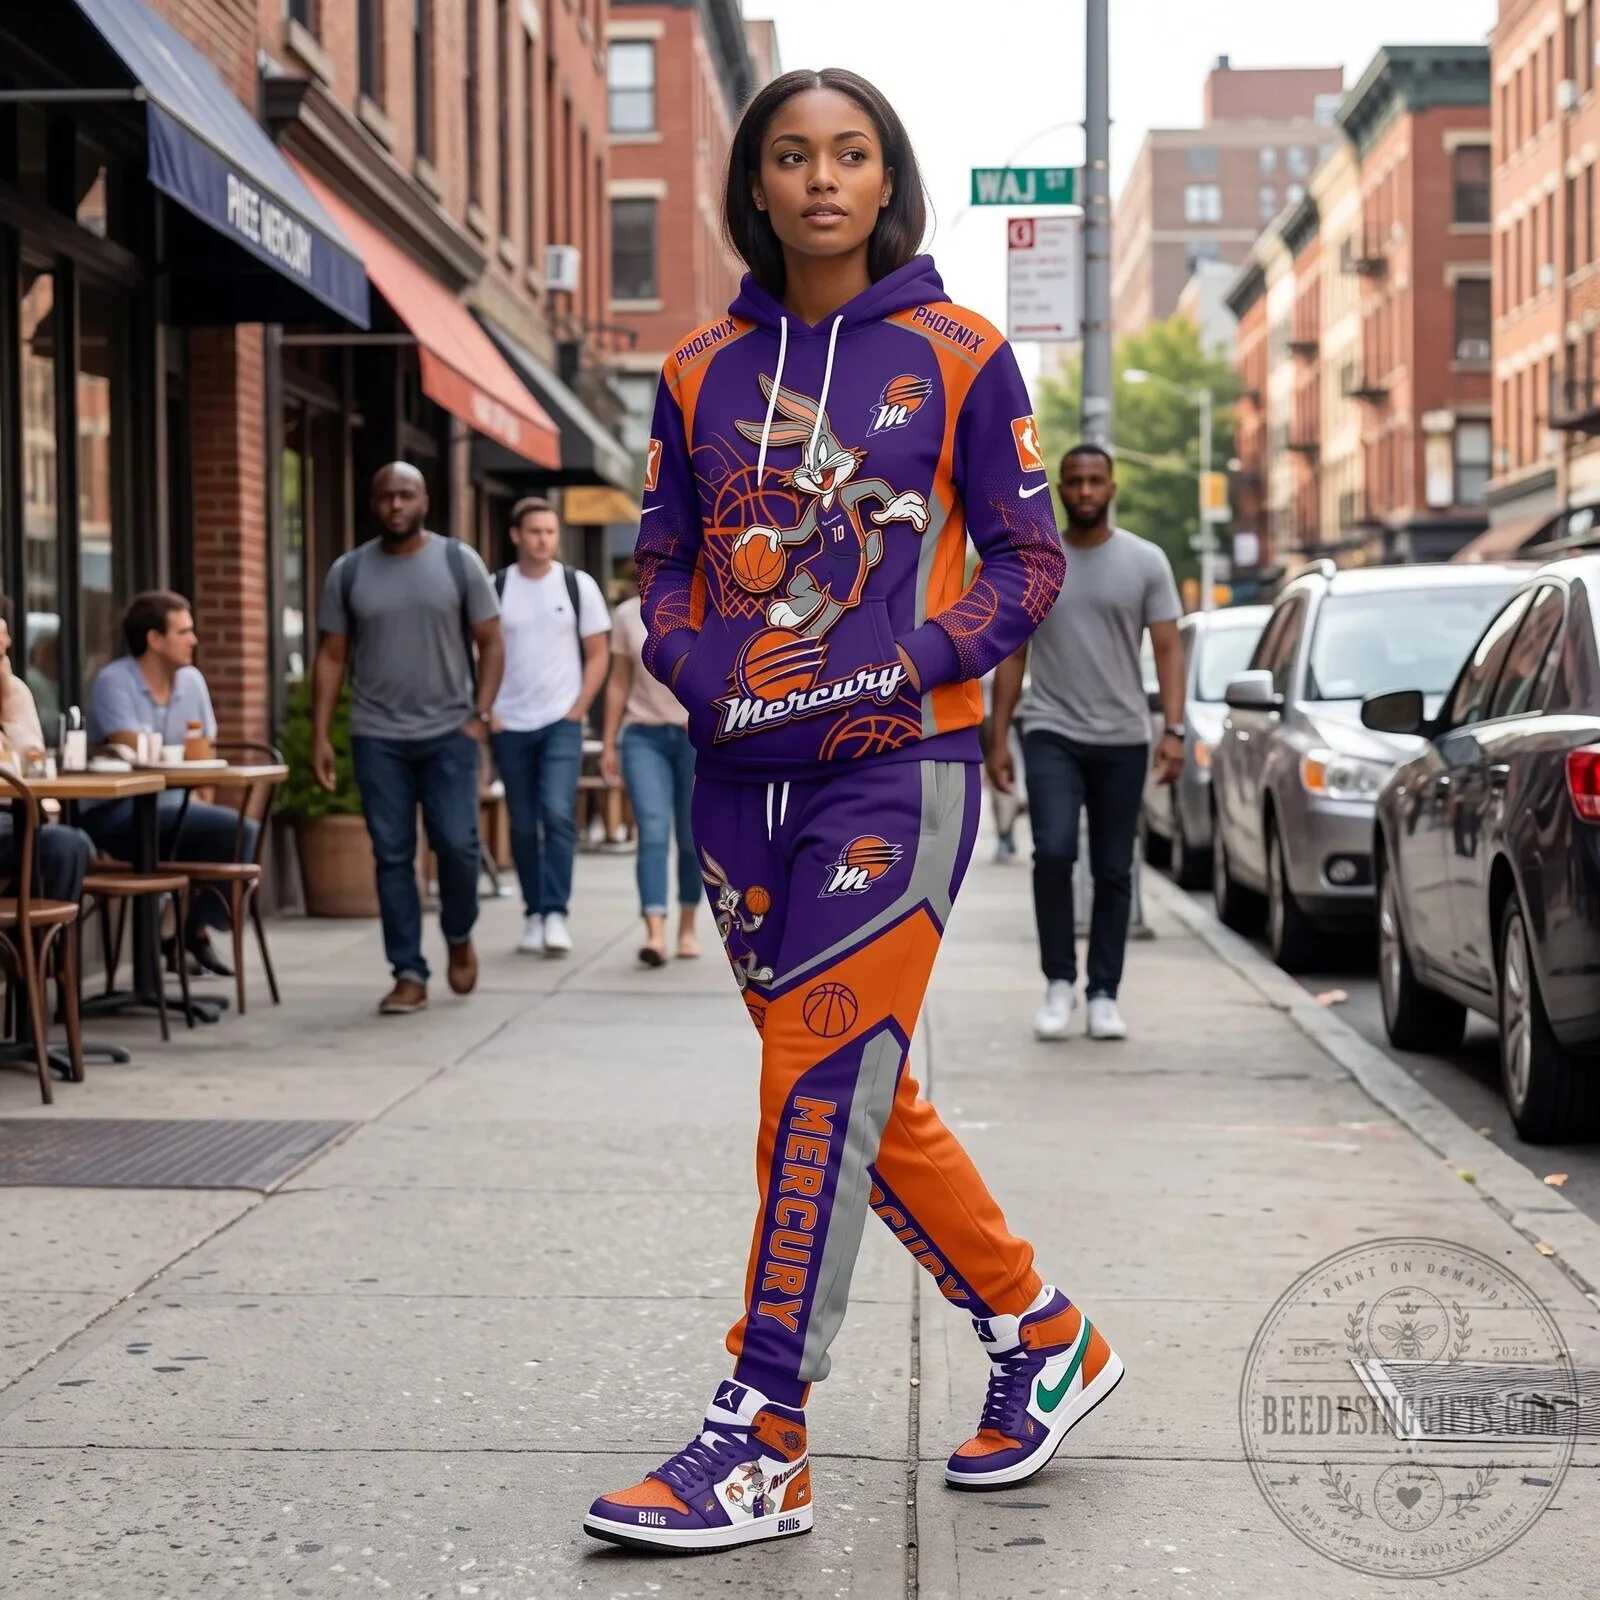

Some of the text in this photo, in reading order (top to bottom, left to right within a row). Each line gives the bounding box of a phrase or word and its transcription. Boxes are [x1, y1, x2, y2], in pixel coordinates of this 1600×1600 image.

[976, 170, 1036, 203] WAJ
[675, 317, 738, 367] PHOENIX
[911, 305, 987, 355] PHOENIX
[831, 524, 845, 543] 10
[720, 662, 908, 736] Mercury
[758, 1095, 837, 1334] MERCURY
[638, 1511, 667, 1526] Bills
